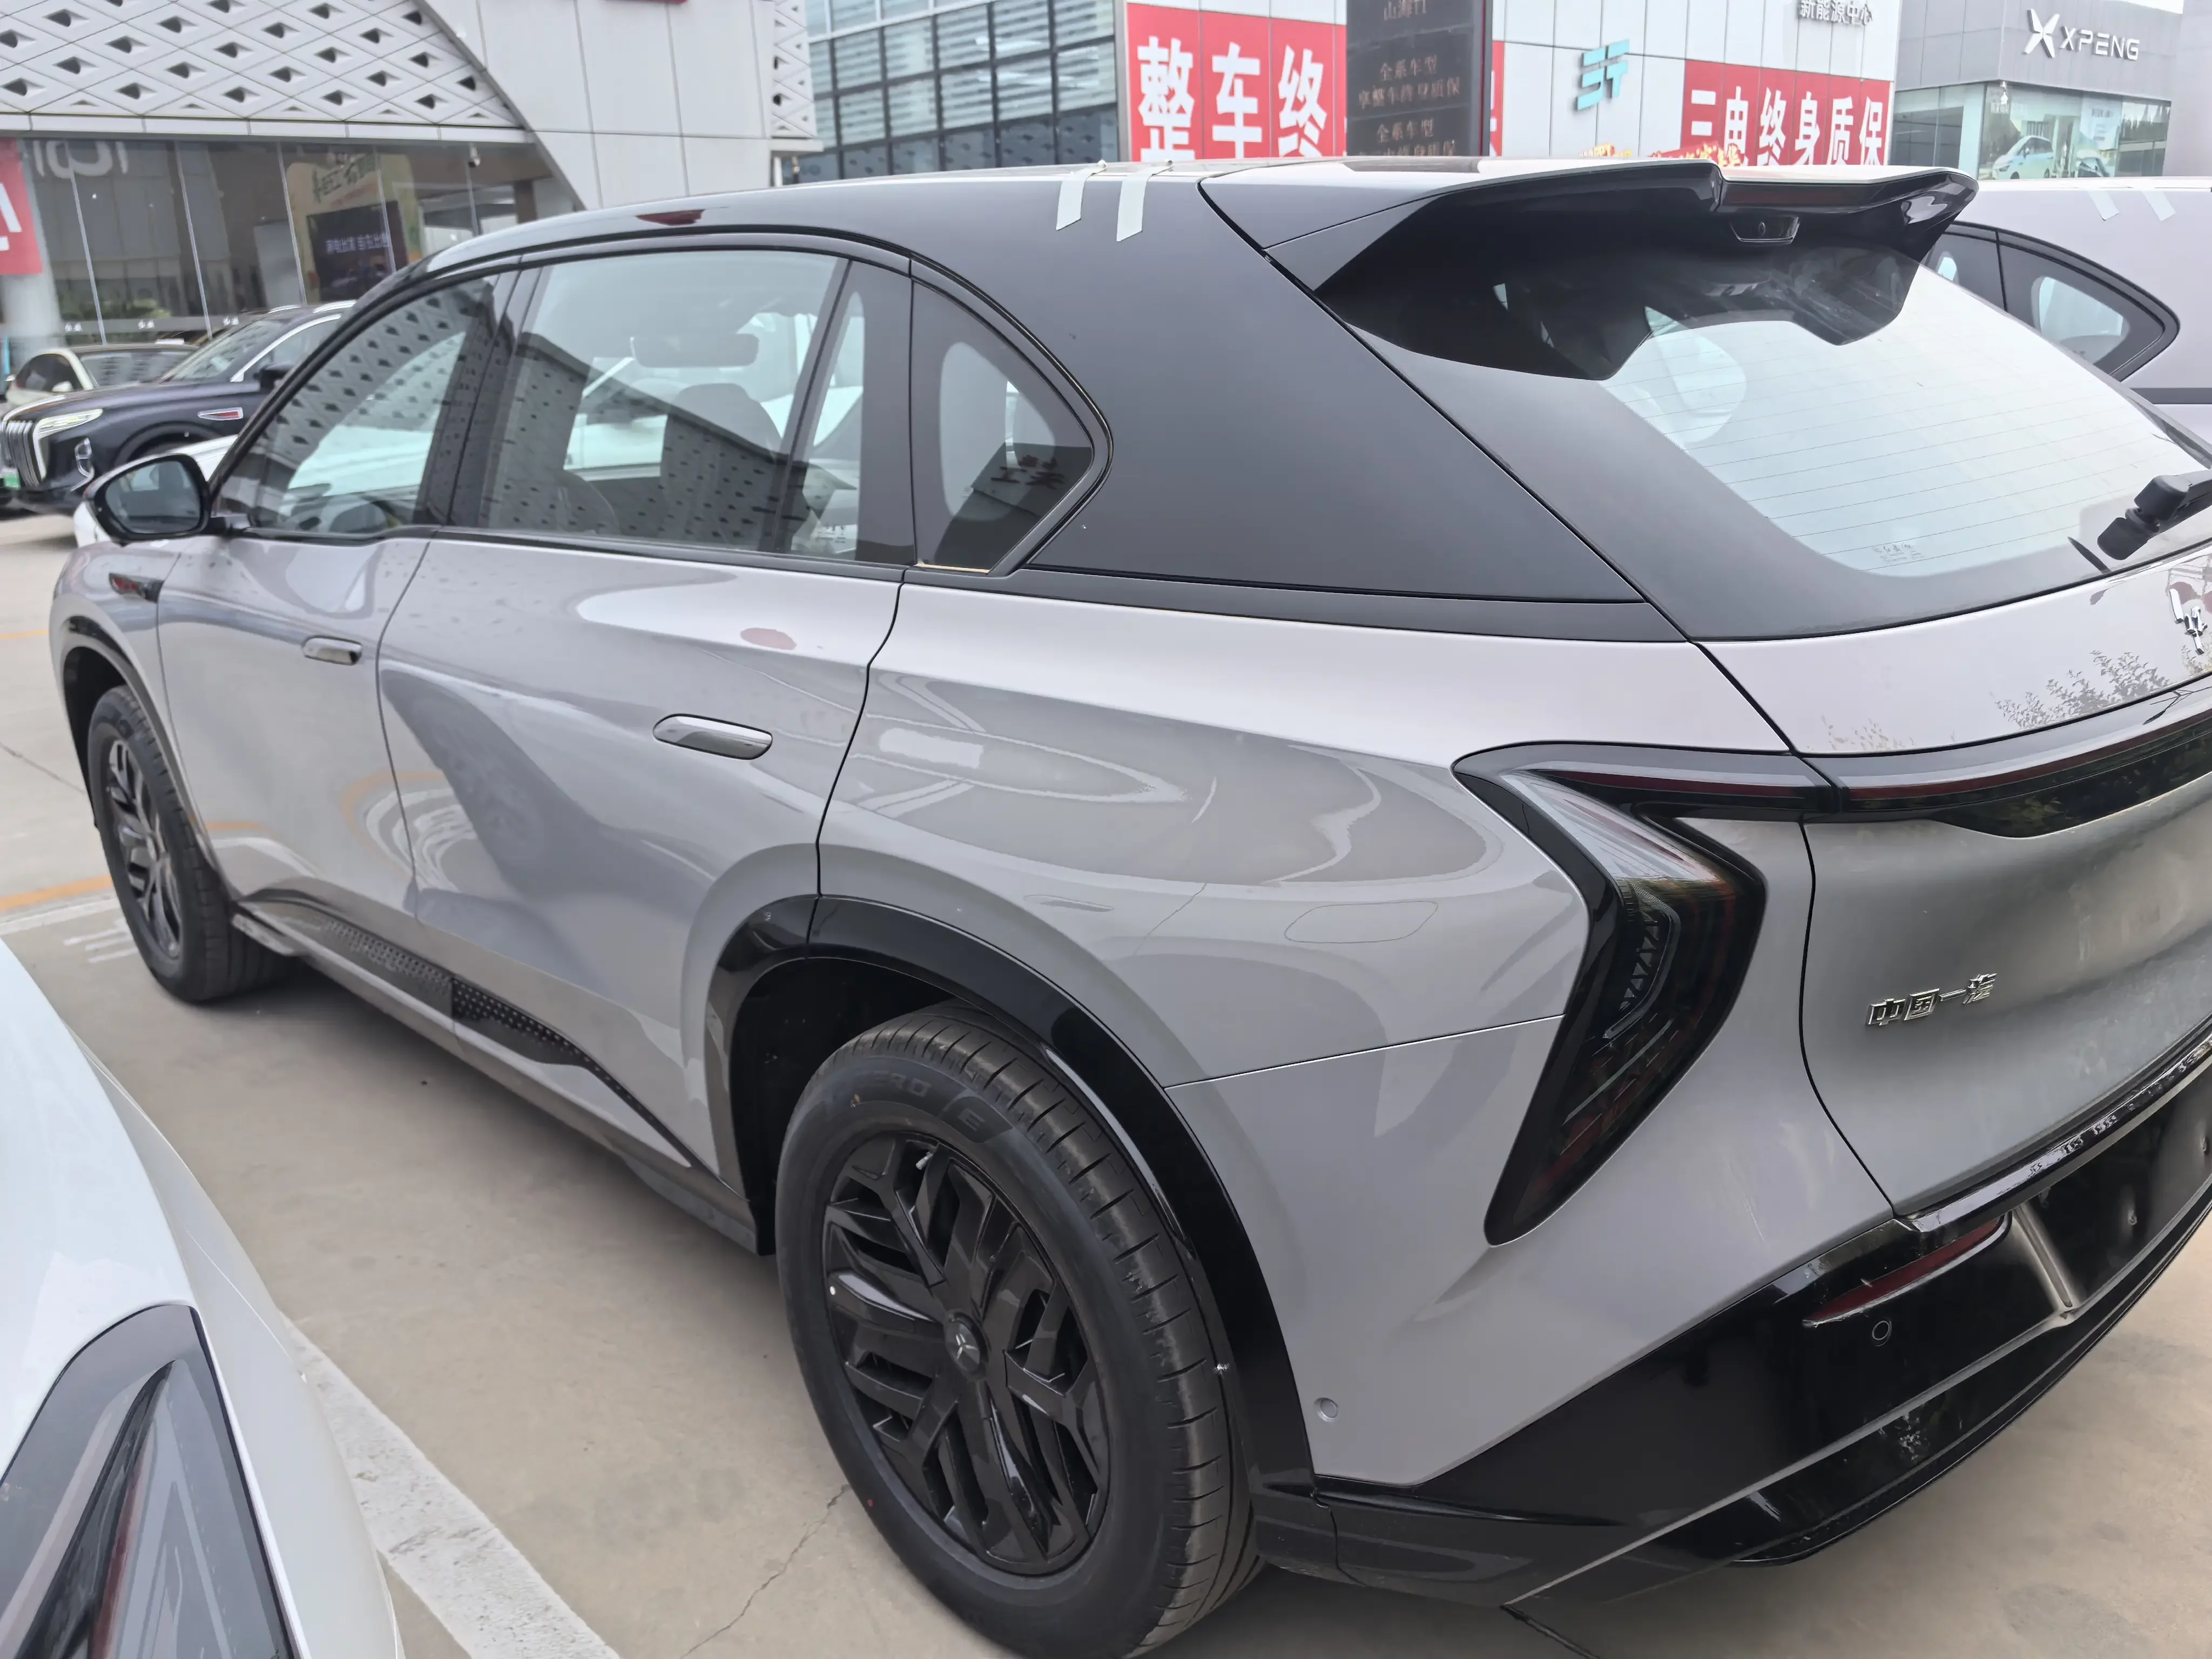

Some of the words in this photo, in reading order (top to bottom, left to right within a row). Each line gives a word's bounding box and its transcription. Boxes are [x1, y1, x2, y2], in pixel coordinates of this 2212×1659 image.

[1799, 0, 1872, 25] 新能源中心
[2059, 25, 2140, 60] XPENG
[1690, 86, 1884, 166] 三电终身质保
[1866, 973, 1997, 1026] 中国一汽
